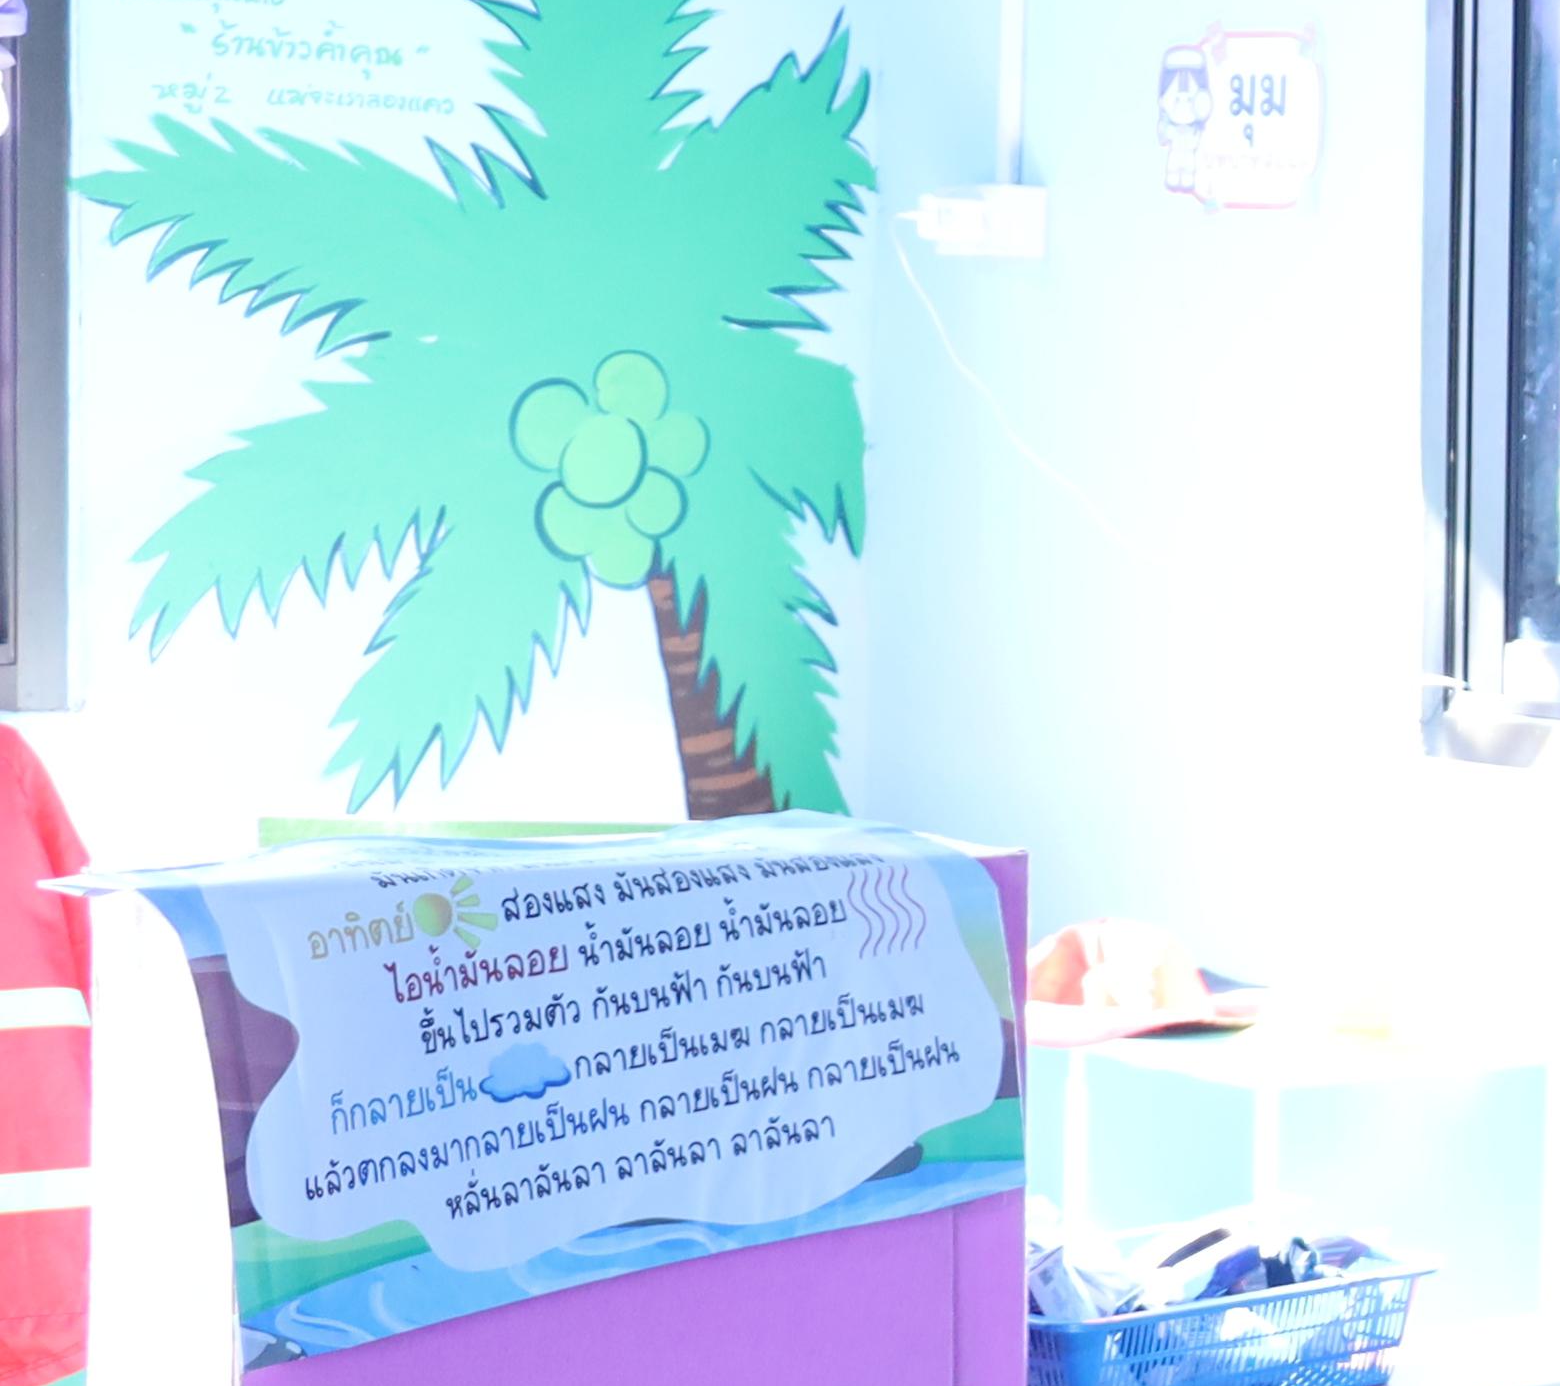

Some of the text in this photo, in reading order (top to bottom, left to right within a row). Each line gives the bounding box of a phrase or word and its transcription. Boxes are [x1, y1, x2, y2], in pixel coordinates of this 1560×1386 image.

[1229, 74, 1287, 148] มุม
[307, 901, 415, 960] อาทิตย์
[384, 896, 848, 1003] ไอน้ำมันลอย น้ำมันลอย น้ำมันลอย
[419, 947, 827, 1054] ขึ้นไปรวมตัว กันบนฟ้า กันบนฟ้า
[331, 992, 924, 1135] ก็กลายเป็น กลายเป็นเมฆ กลายเป็นเมฆ
[305, 1036, 960, 1200] แล้วตกลงมากลายเป็นฝน กลายเป็นฝน กลายเป็นฝน
[616, 1136, 721, 1180] ลาลันลา
[731, 1114, 835, 1157] ลาลันลา
